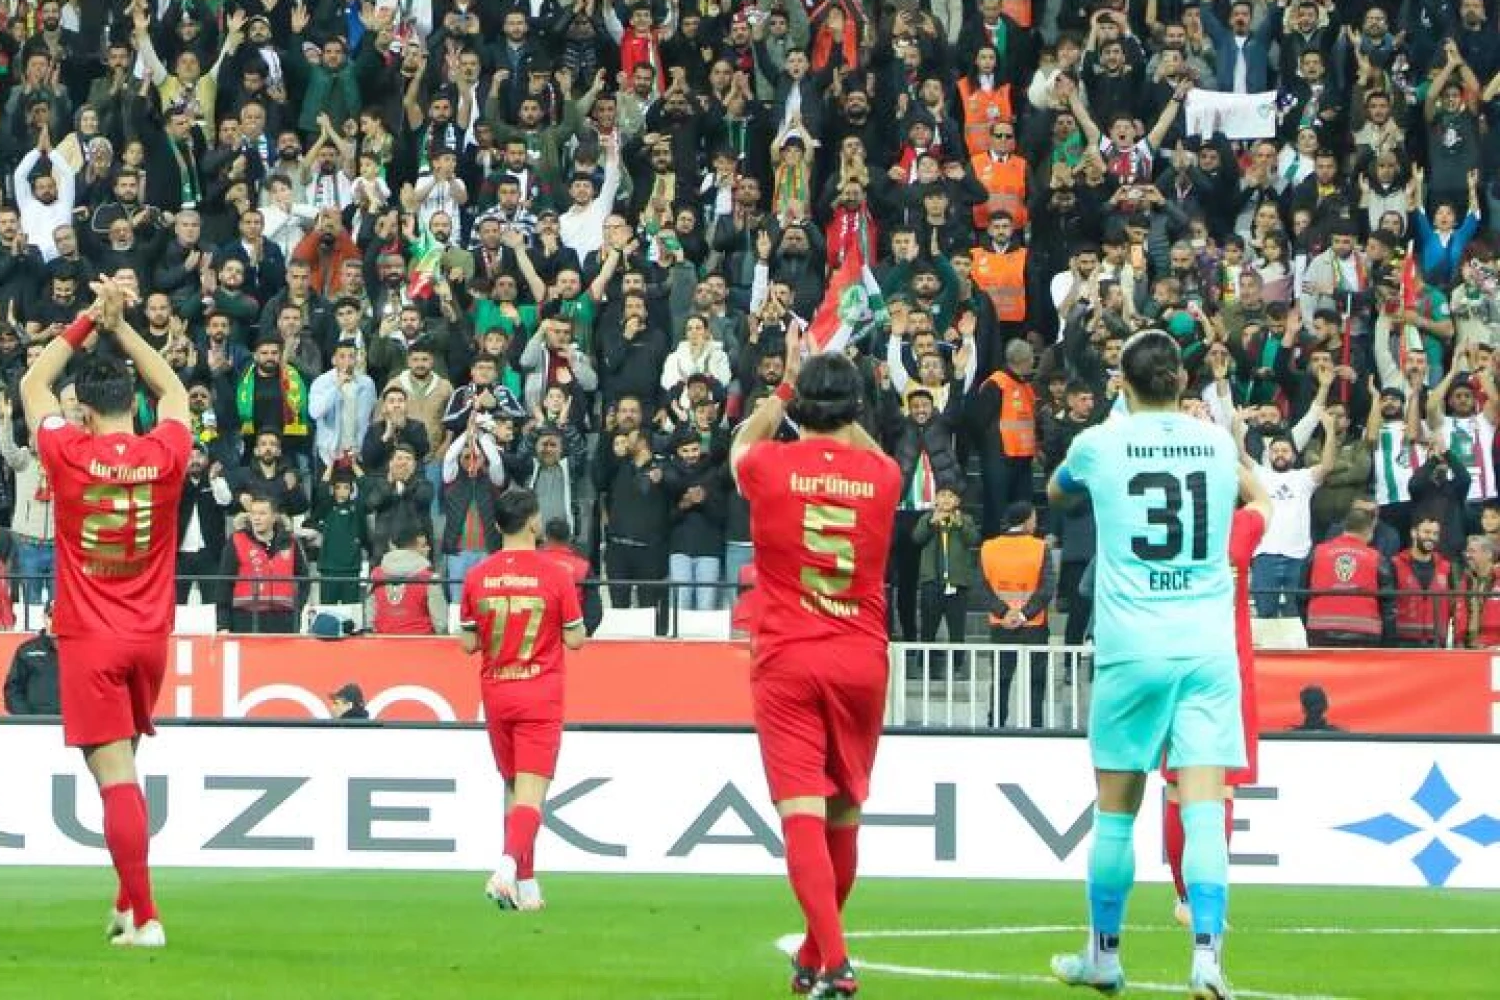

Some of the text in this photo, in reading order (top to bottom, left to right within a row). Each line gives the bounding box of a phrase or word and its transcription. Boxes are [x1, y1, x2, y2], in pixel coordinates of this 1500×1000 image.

[81, 485, 152, 557] 21
[801, 504, 857, 595] 5
[1128, 471, 1207, 561] 31
[479, 596, 546, 660] 77
